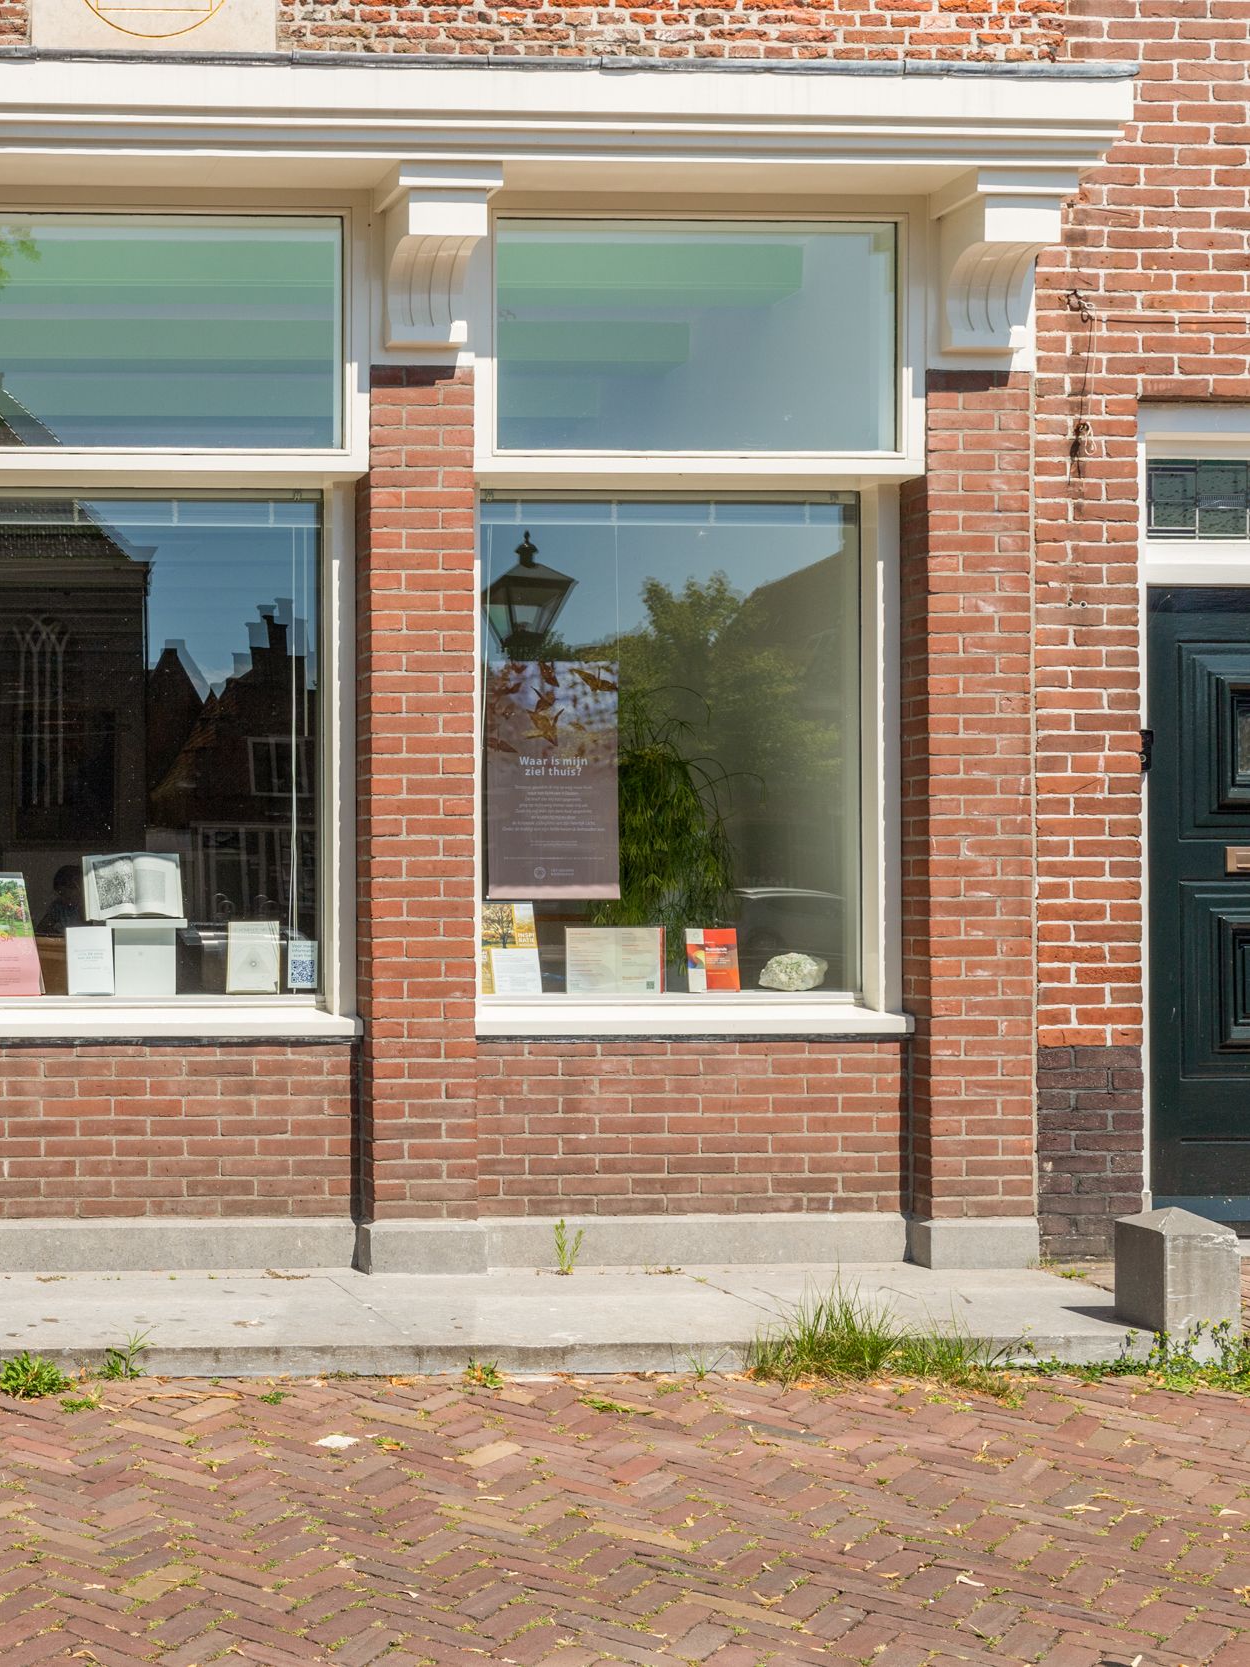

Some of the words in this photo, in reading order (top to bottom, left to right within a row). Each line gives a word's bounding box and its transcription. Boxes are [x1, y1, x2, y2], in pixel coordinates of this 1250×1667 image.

[519, 756, 548, 766] Waar
[551, 756, 560, 766] is
[562, 756, 588, 768] mijn
[525, 766, 545, 776] ziel
[549, 766, 582, 776] thuis?
